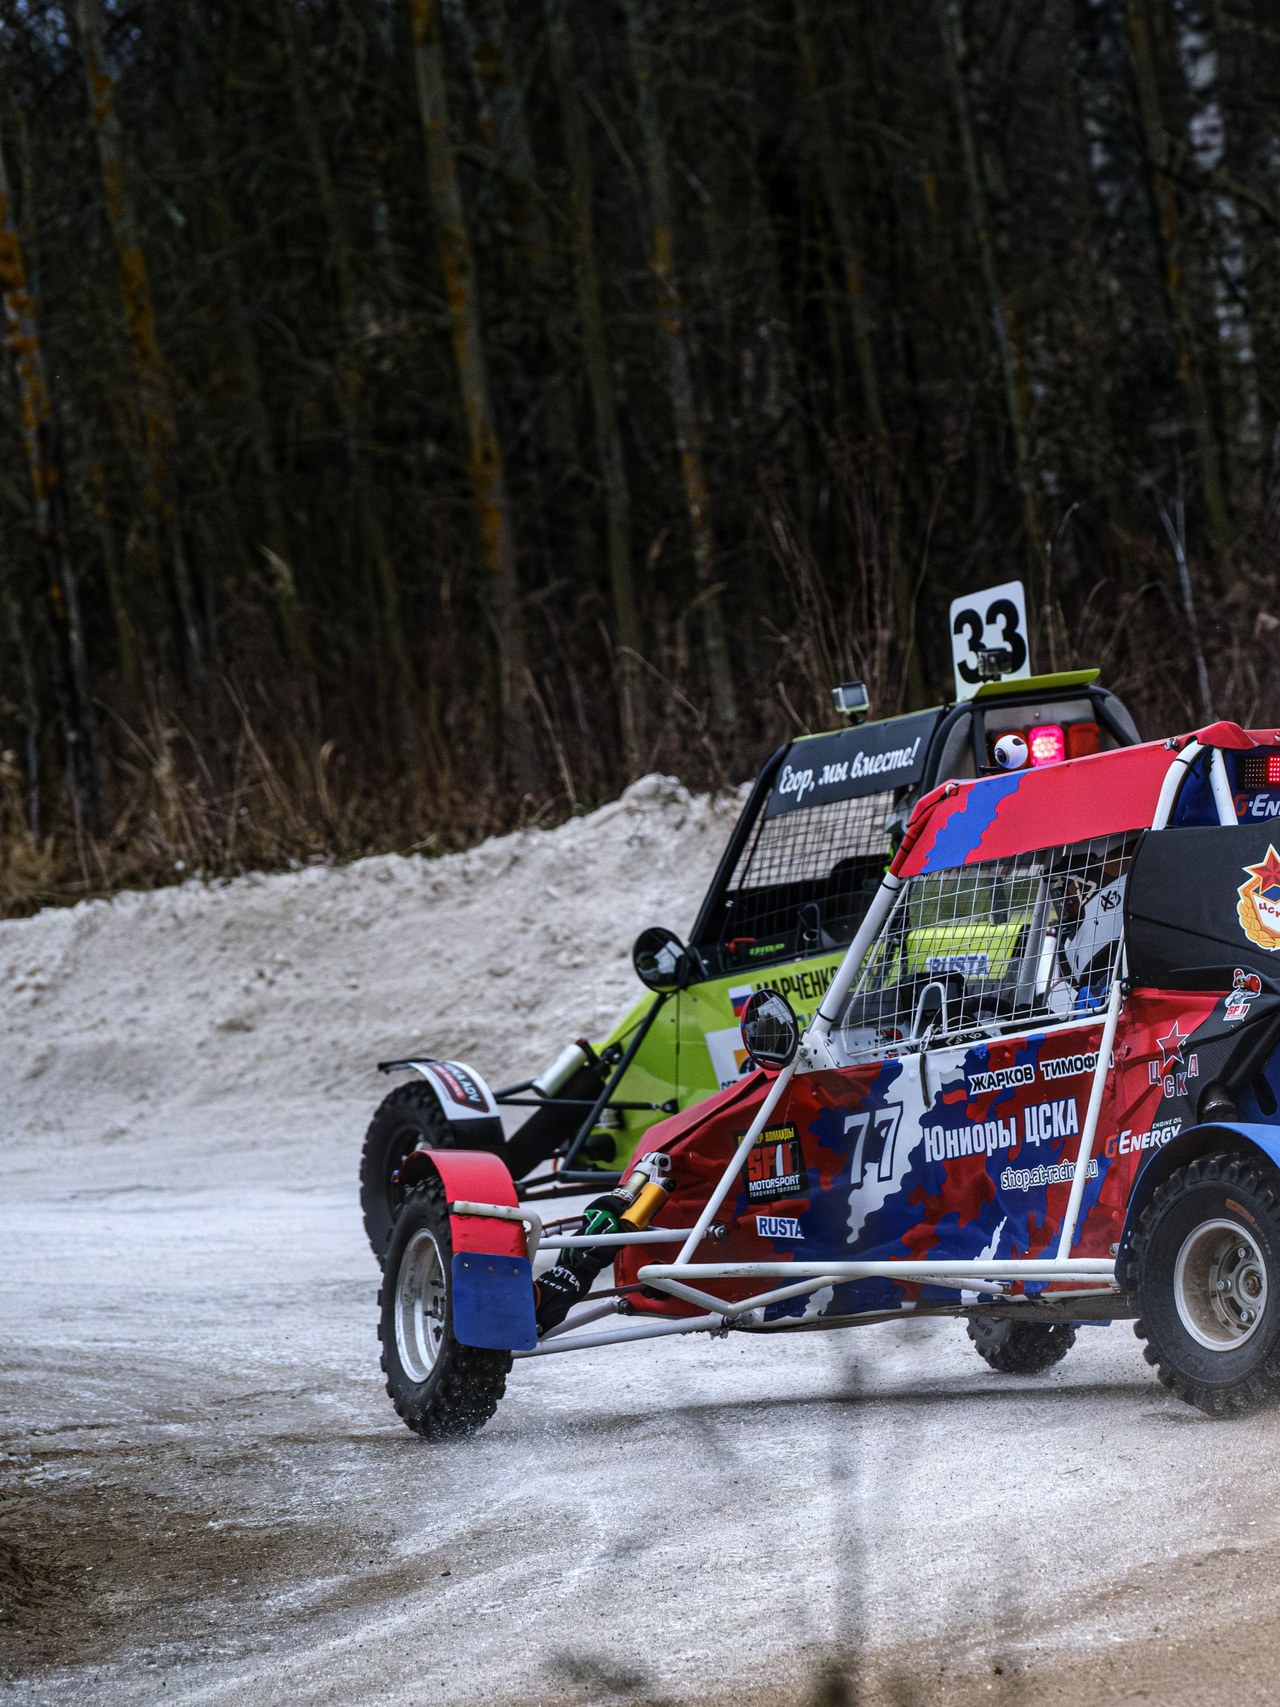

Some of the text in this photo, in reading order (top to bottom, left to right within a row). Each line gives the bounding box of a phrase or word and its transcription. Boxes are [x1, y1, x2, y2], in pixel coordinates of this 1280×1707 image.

[954, 598, 1026, 684] 33
[779, 737, 921, 802] Егор, мы вместе!
[971, 1052, 1113, 1092] ЖАРКОВ ТИМОФ
[1149, 1054, 1198, 1098] ЦСКА
[844, 1104, 902, 1184] 77
[924, 1098, 1079, 1162] Юниоры ЦСКА
[749, 1175, 800, 1191] MOTORSPORT
